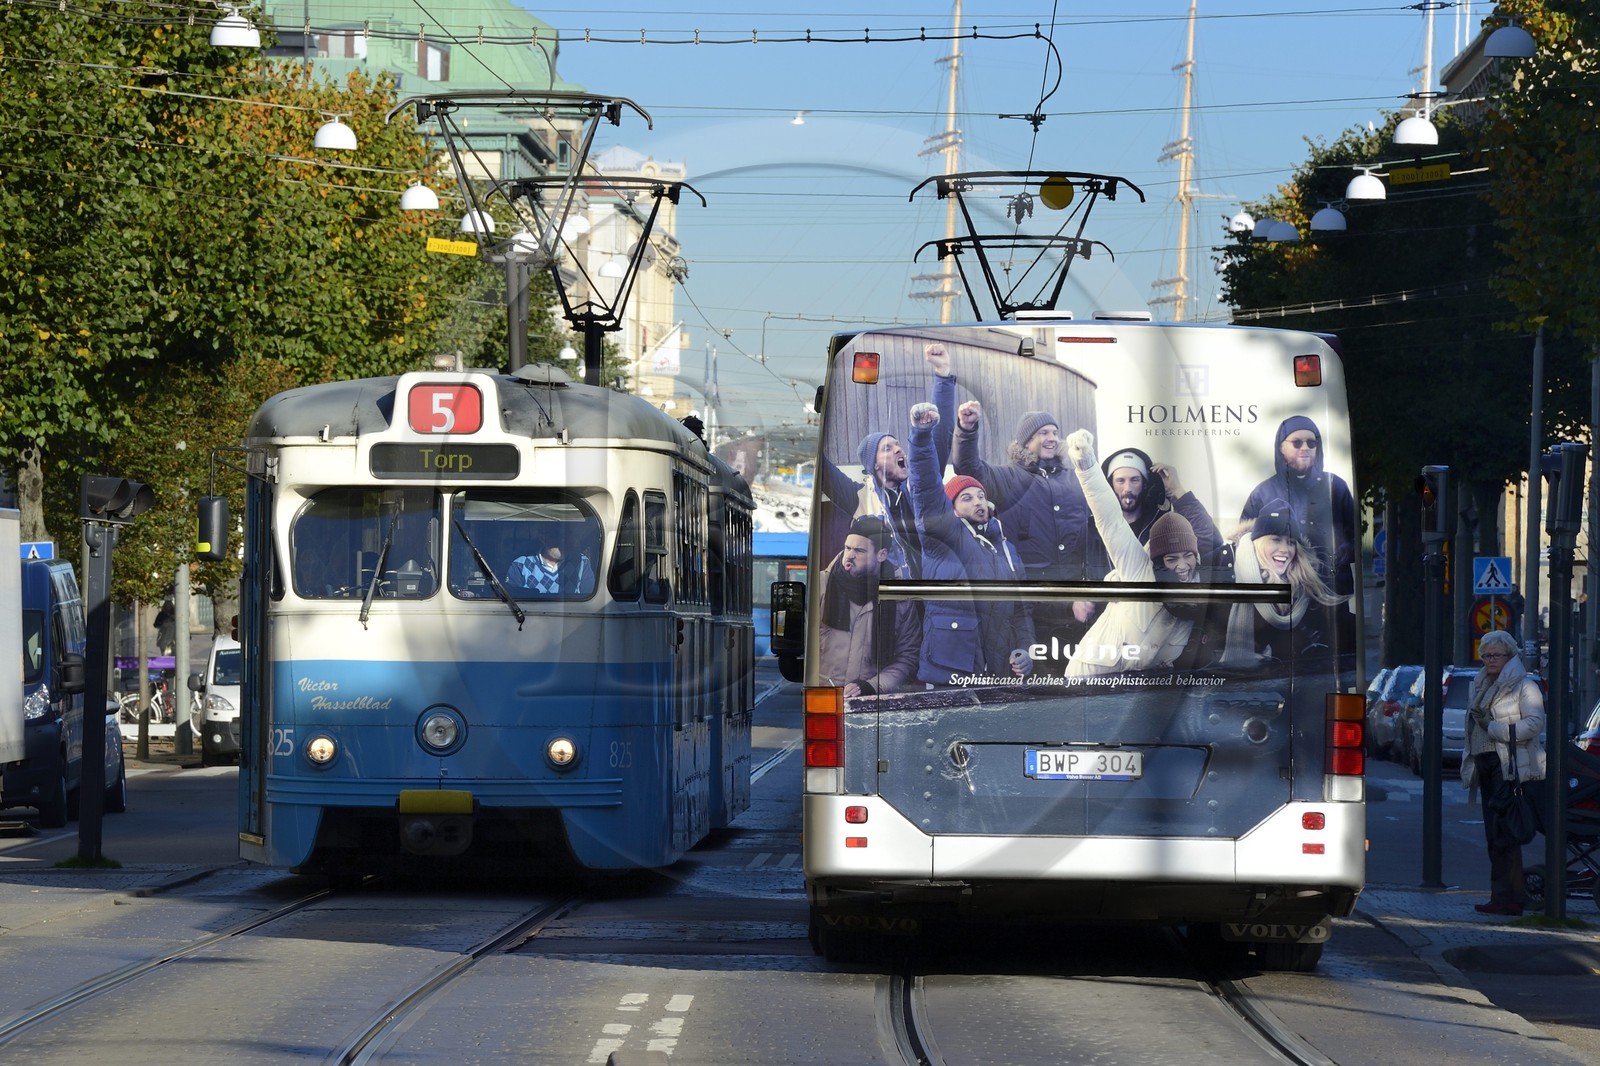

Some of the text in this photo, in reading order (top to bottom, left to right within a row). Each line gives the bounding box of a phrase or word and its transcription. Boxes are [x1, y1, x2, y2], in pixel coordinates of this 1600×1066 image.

[431, 392, 455, 433] 5
[1127, 404, 1258, 424] HOLMENS
[1145, 428, 1241, 437] HERREKIPERING
[418, 449, 473, 472] Torp
[1028, 636, 1141, 661] elvine
[297, 677, 339, 692] Victor
[949, 673, 1226, 688] Sophisticated clothes for unsophisticated behavior
[310, 695, 393, 711] Hasselblad
[267, 728, 294, 757] 825
[609, 740, 632, 768] 825
[1039, 754, 1137, 773] BWP 304
[822, 913, 918, 930] VOLVO
[1226, 922, 1328, 939] VOLVO
